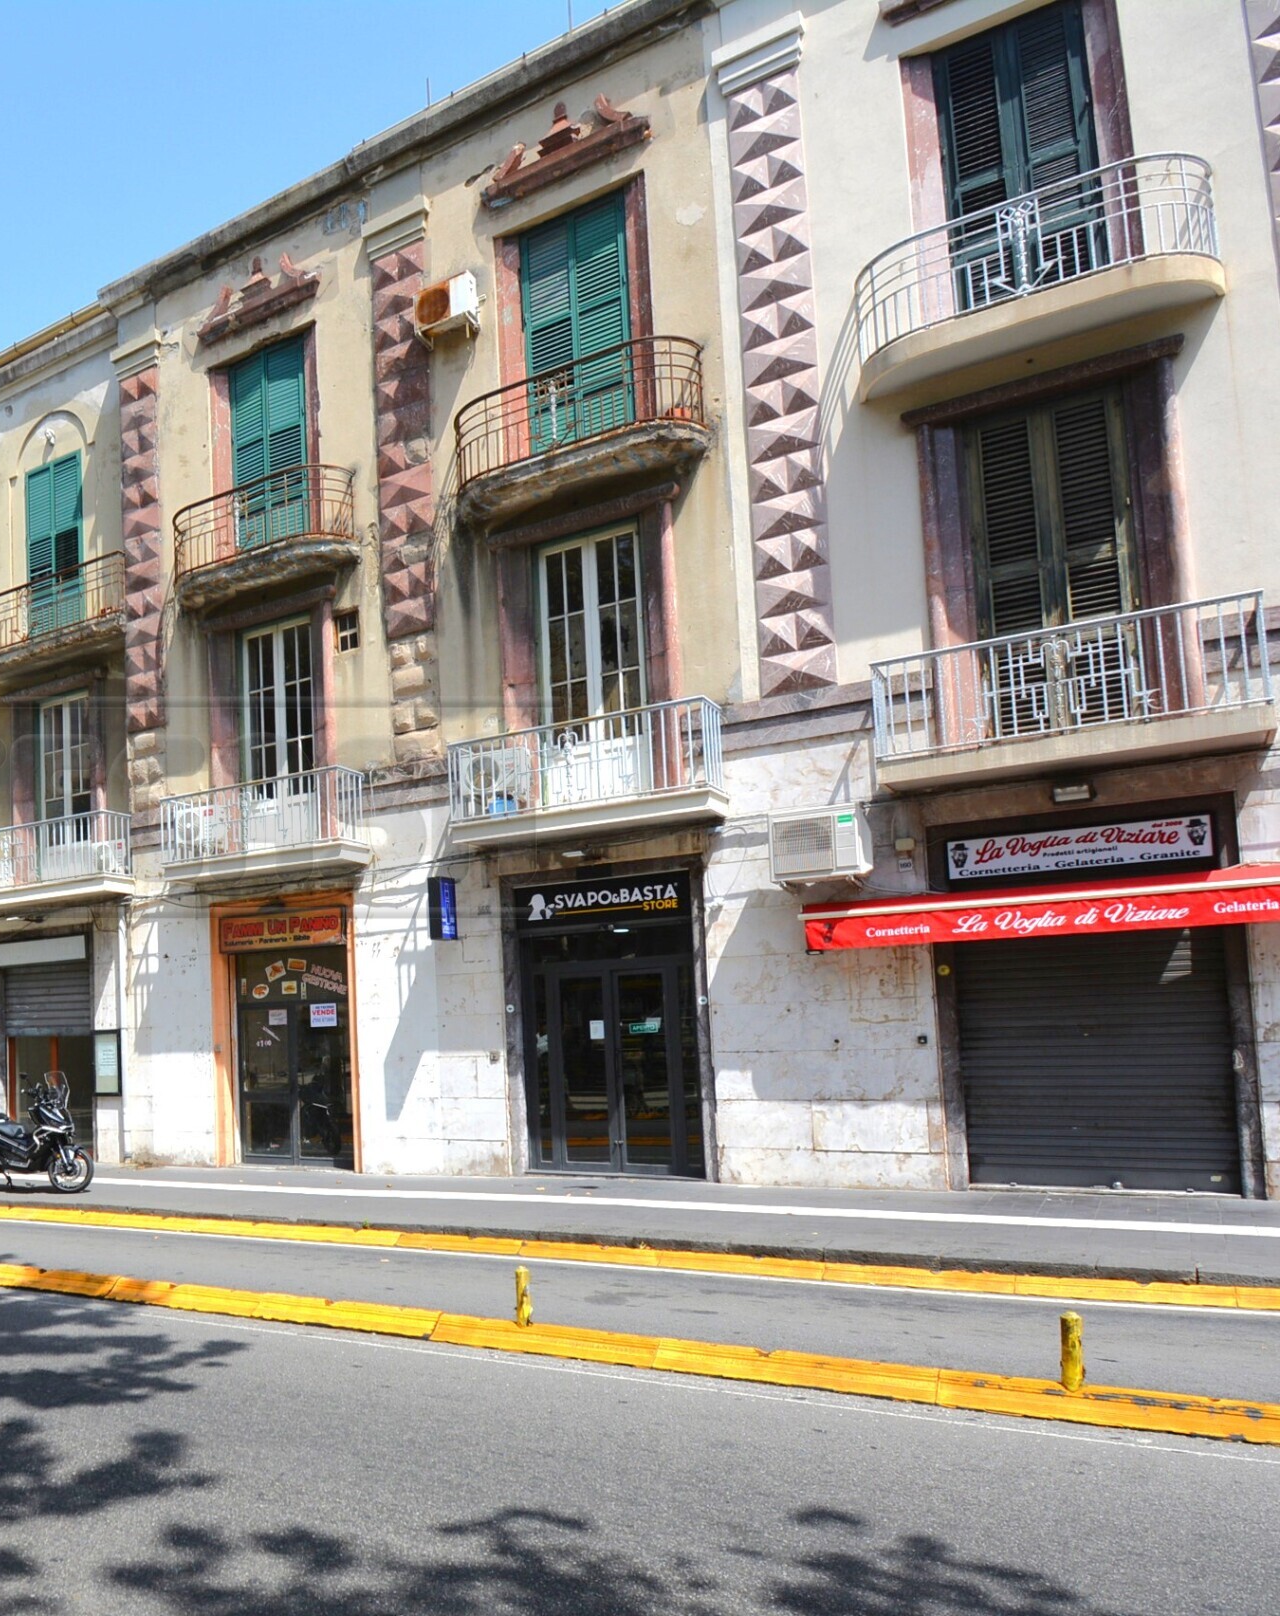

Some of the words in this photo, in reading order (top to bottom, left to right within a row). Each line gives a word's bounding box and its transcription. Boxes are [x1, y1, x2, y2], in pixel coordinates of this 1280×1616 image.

[974, 839, 1006, 865] La
[1006, 834, 1073, 857] Voglia
[1075, 829, 1098, 843] di
[1101, 826, 1180, 845] Viziare
[1042, 849, 1076, 858] Prodotti
[1077, 845, 1119, 855] artigianali
[958, 862, 1040, 877] Cornetteria
[1054, 855, 1124, 869] Gelateria
[1139, 849, 1201, 861] Granite
[554, 884, 677, 909] SVAPO&BASTA
[642, 899, 678, 911] STORE
[865, 923, 931, 938] Cornetteria
[951, 914, 988, 934] La
[993, 909, 1068, 934] Voglia
[1074, 906, 1099, 925] di
[1102, 902, 1191, 924] Viziare
[1213, 898, 1279, 914] Gelateria
[301, 972, 348, 995] GESTIONE
[311, 964, 343, 981] NUOVA
